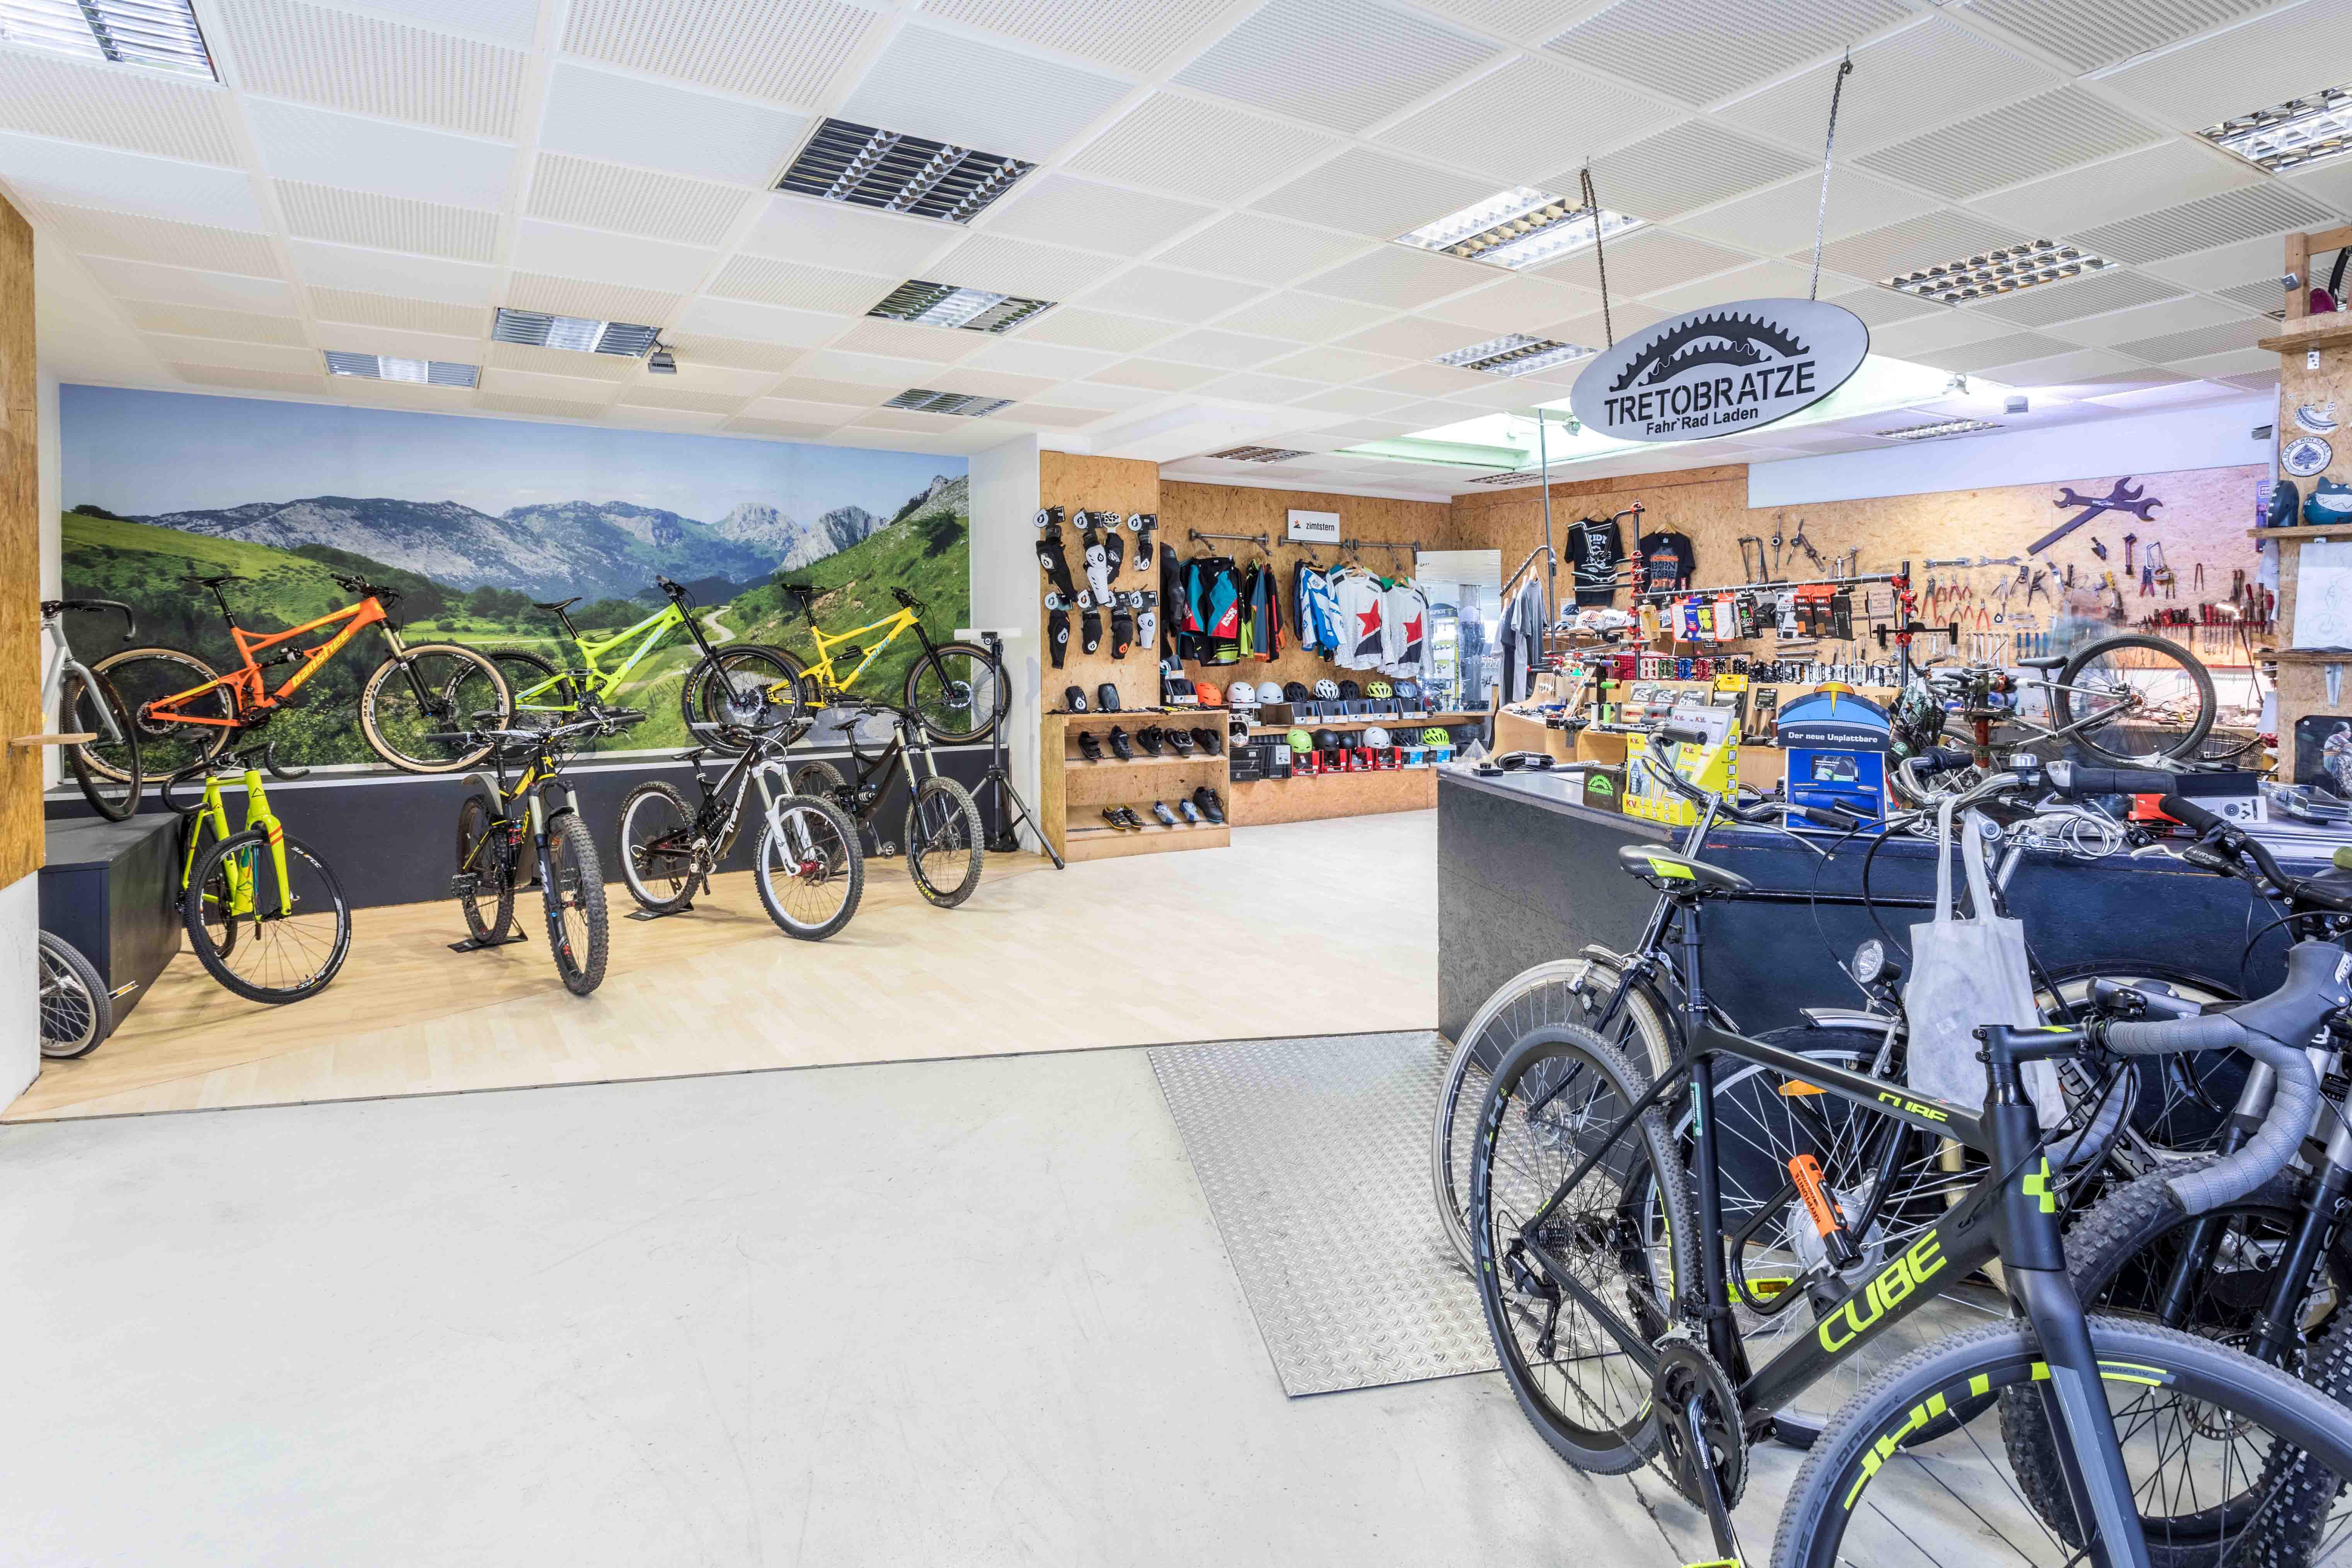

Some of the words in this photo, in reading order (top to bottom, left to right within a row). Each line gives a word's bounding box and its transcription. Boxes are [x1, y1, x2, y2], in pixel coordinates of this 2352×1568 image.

[1604, 360, 1815, 426] TRETOBRATZE
[1713, 407, 1758, 425] Laden
[1306, 522, 1335, 532] zimtstern
[291, 627, 349, 687] banshee
[363, 685, 373, 718] MAXXIS
[1827, 734, 1878, 743] Unplattbare
[726, 765, 751, 833] Transition
[917, 880, 935, 900] MAXXIS
[1878, 1092, 1948, 1122] CUBE
[1795, 1173, 1821, 1224] KRYPTONITE
[1819, 1229, 1948, 1352] CUBE
[1697, 1440, 1709, 1469] SHIMANO
